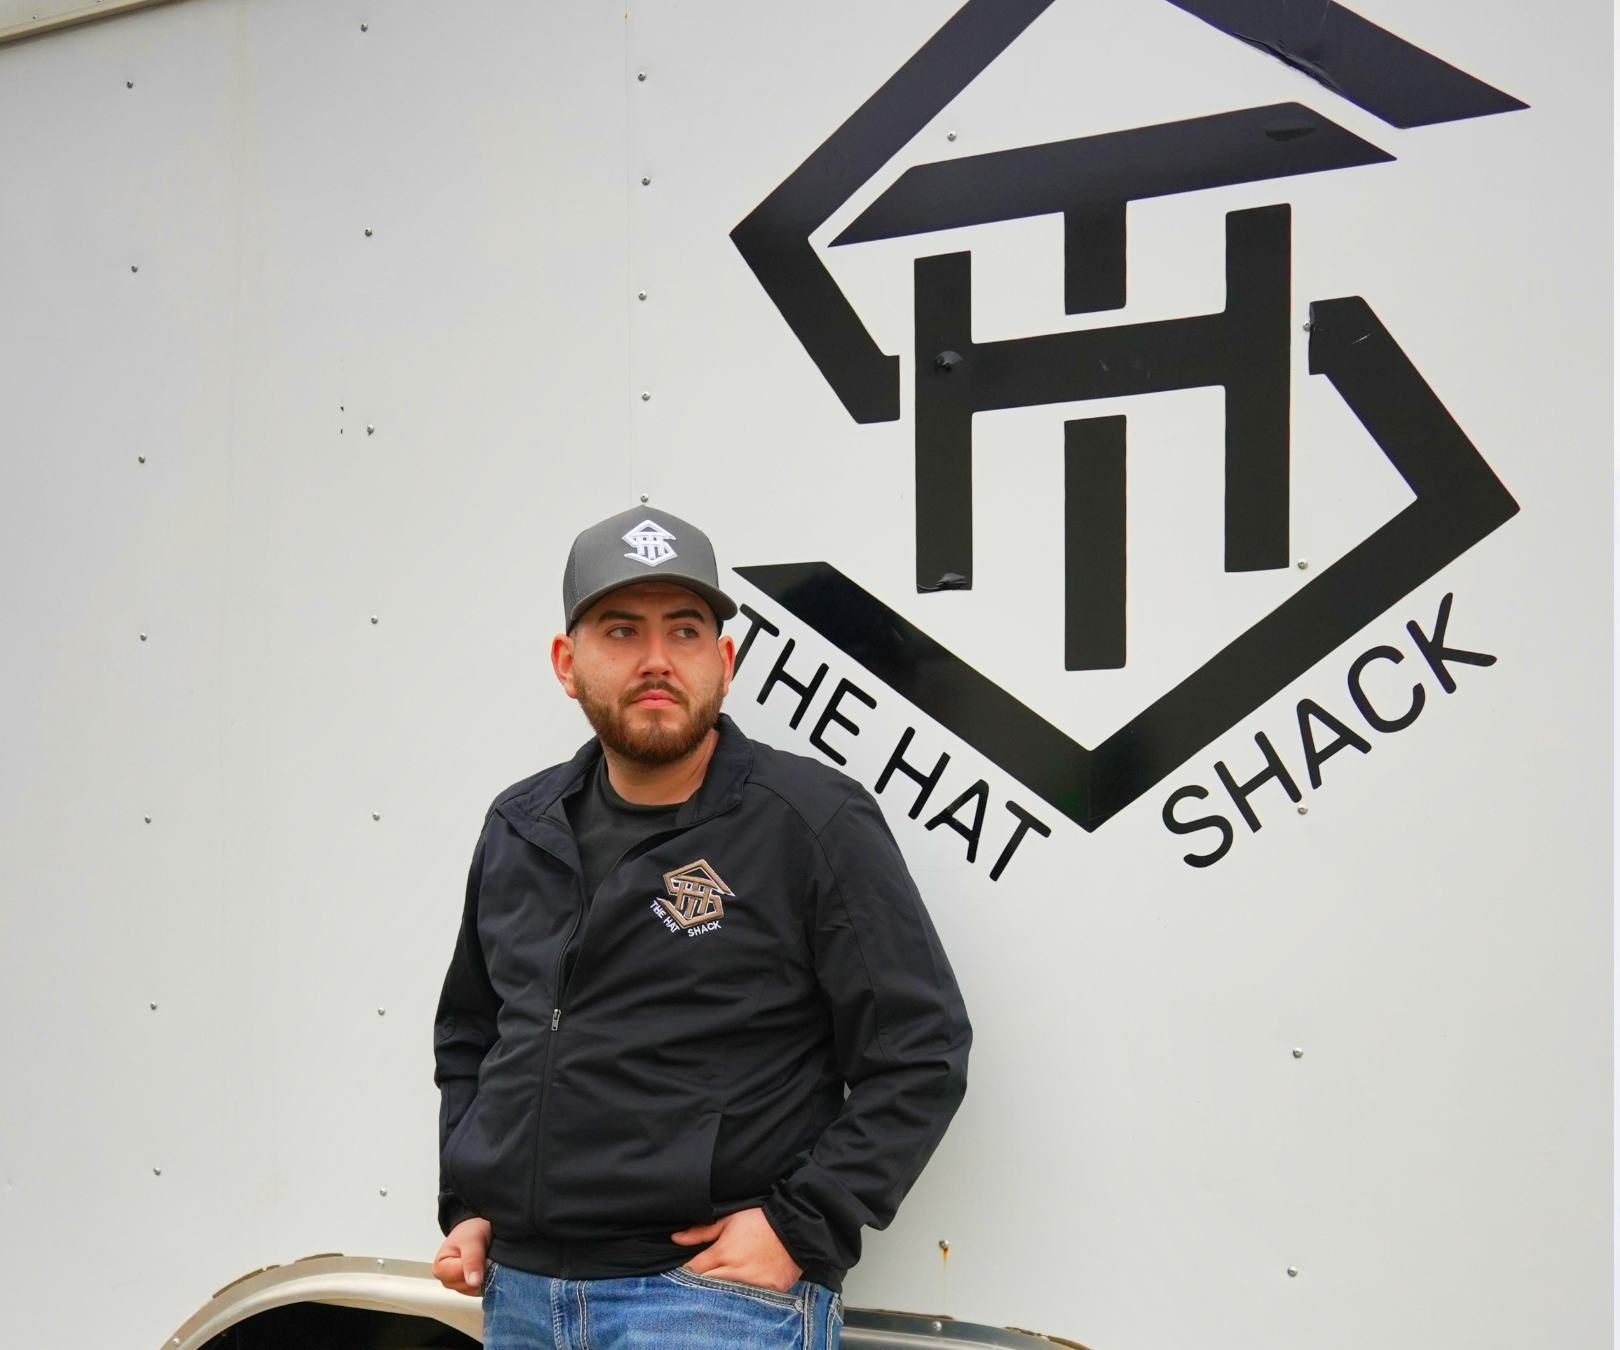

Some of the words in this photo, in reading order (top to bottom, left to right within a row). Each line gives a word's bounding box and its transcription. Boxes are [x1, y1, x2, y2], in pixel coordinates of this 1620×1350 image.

[732, 603, 878, 767] THE
[873, 726, 1052, 882] HAT
[1162, 592, 1498, 869] SHACK
[650, 899, 667, 919] THE
[663, 915, 681, 933] HAT
[687, 920, 722, 938] SHACK
